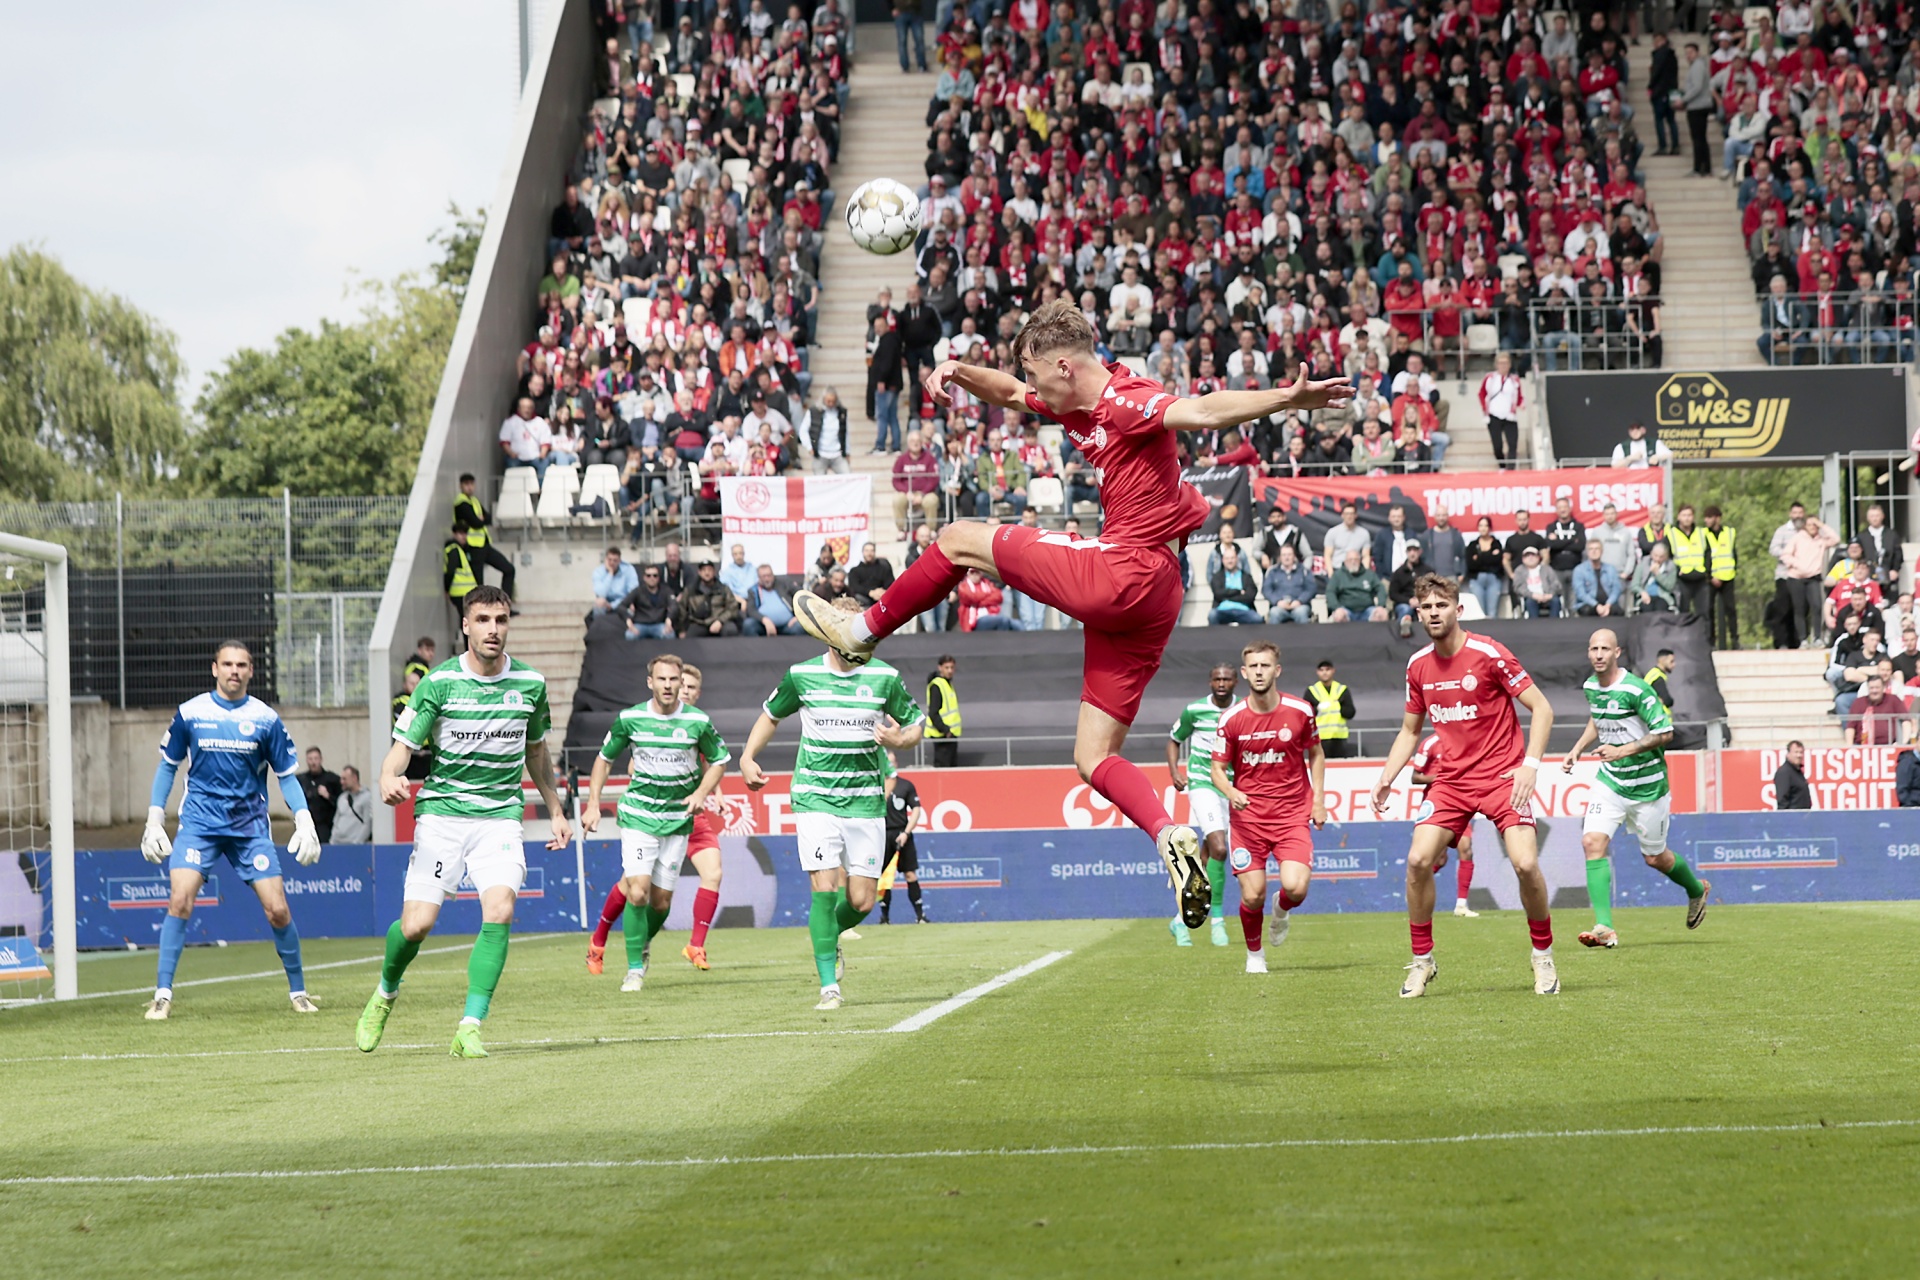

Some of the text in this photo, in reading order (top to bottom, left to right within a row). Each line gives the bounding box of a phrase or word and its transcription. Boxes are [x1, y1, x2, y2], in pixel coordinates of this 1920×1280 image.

[1688, 398, 1752, 425] W&S
[1069, 429, 1084, 443] JAKO
[1657, 428, 1702, 439] TECHNIK
[1671, 449, 1707, 458] RVICES
[1423, 482, 1659, 518] TOPMODELS ESSEN
[797, 517, 820, 534] der
[1429, 700, 1478, 724] Stauder
[1242, 748, 1286, 767] Stauder
[1207, 812, 1215, 822] 8
[1589, 803, 1602, 814] 25
[636, 848, 643, 860] 3
[815, 846, 823, 861] 4
[1713, 844, 1820, 862] Sparda-Bank
[434, 861, 443, 879] 2
[1051, 859, 1169, 880] sparda-west.
